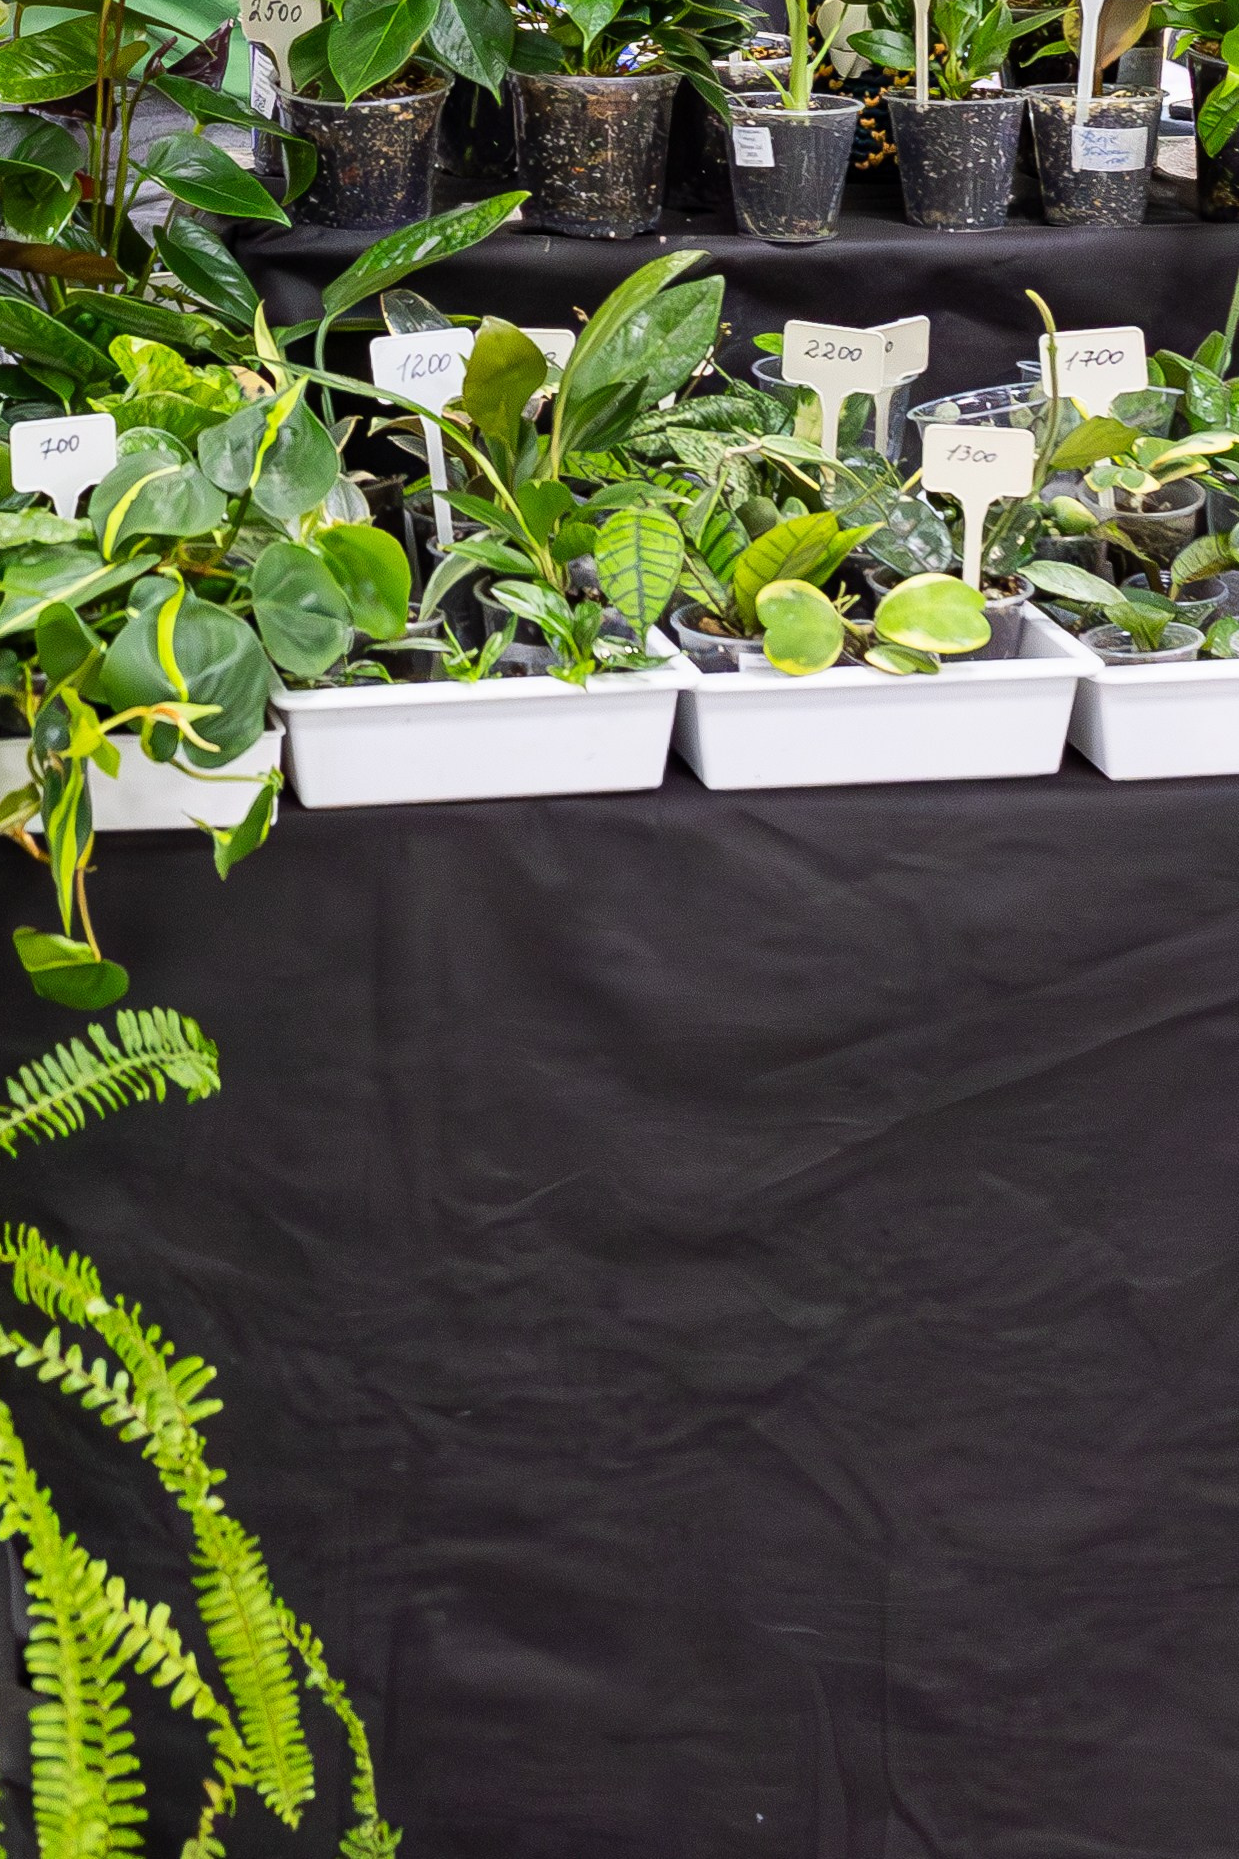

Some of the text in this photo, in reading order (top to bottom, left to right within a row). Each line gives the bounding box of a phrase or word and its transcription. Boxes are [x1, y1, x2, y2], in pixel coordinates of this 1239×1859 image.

[804, 339, 863, 362] 2200
[1064, 348, 1124, 371] 1700
[396, 353, 452, 383] 1200
[40, 434, 80, 461] 700
[946, 444, 998, 463] 1300
